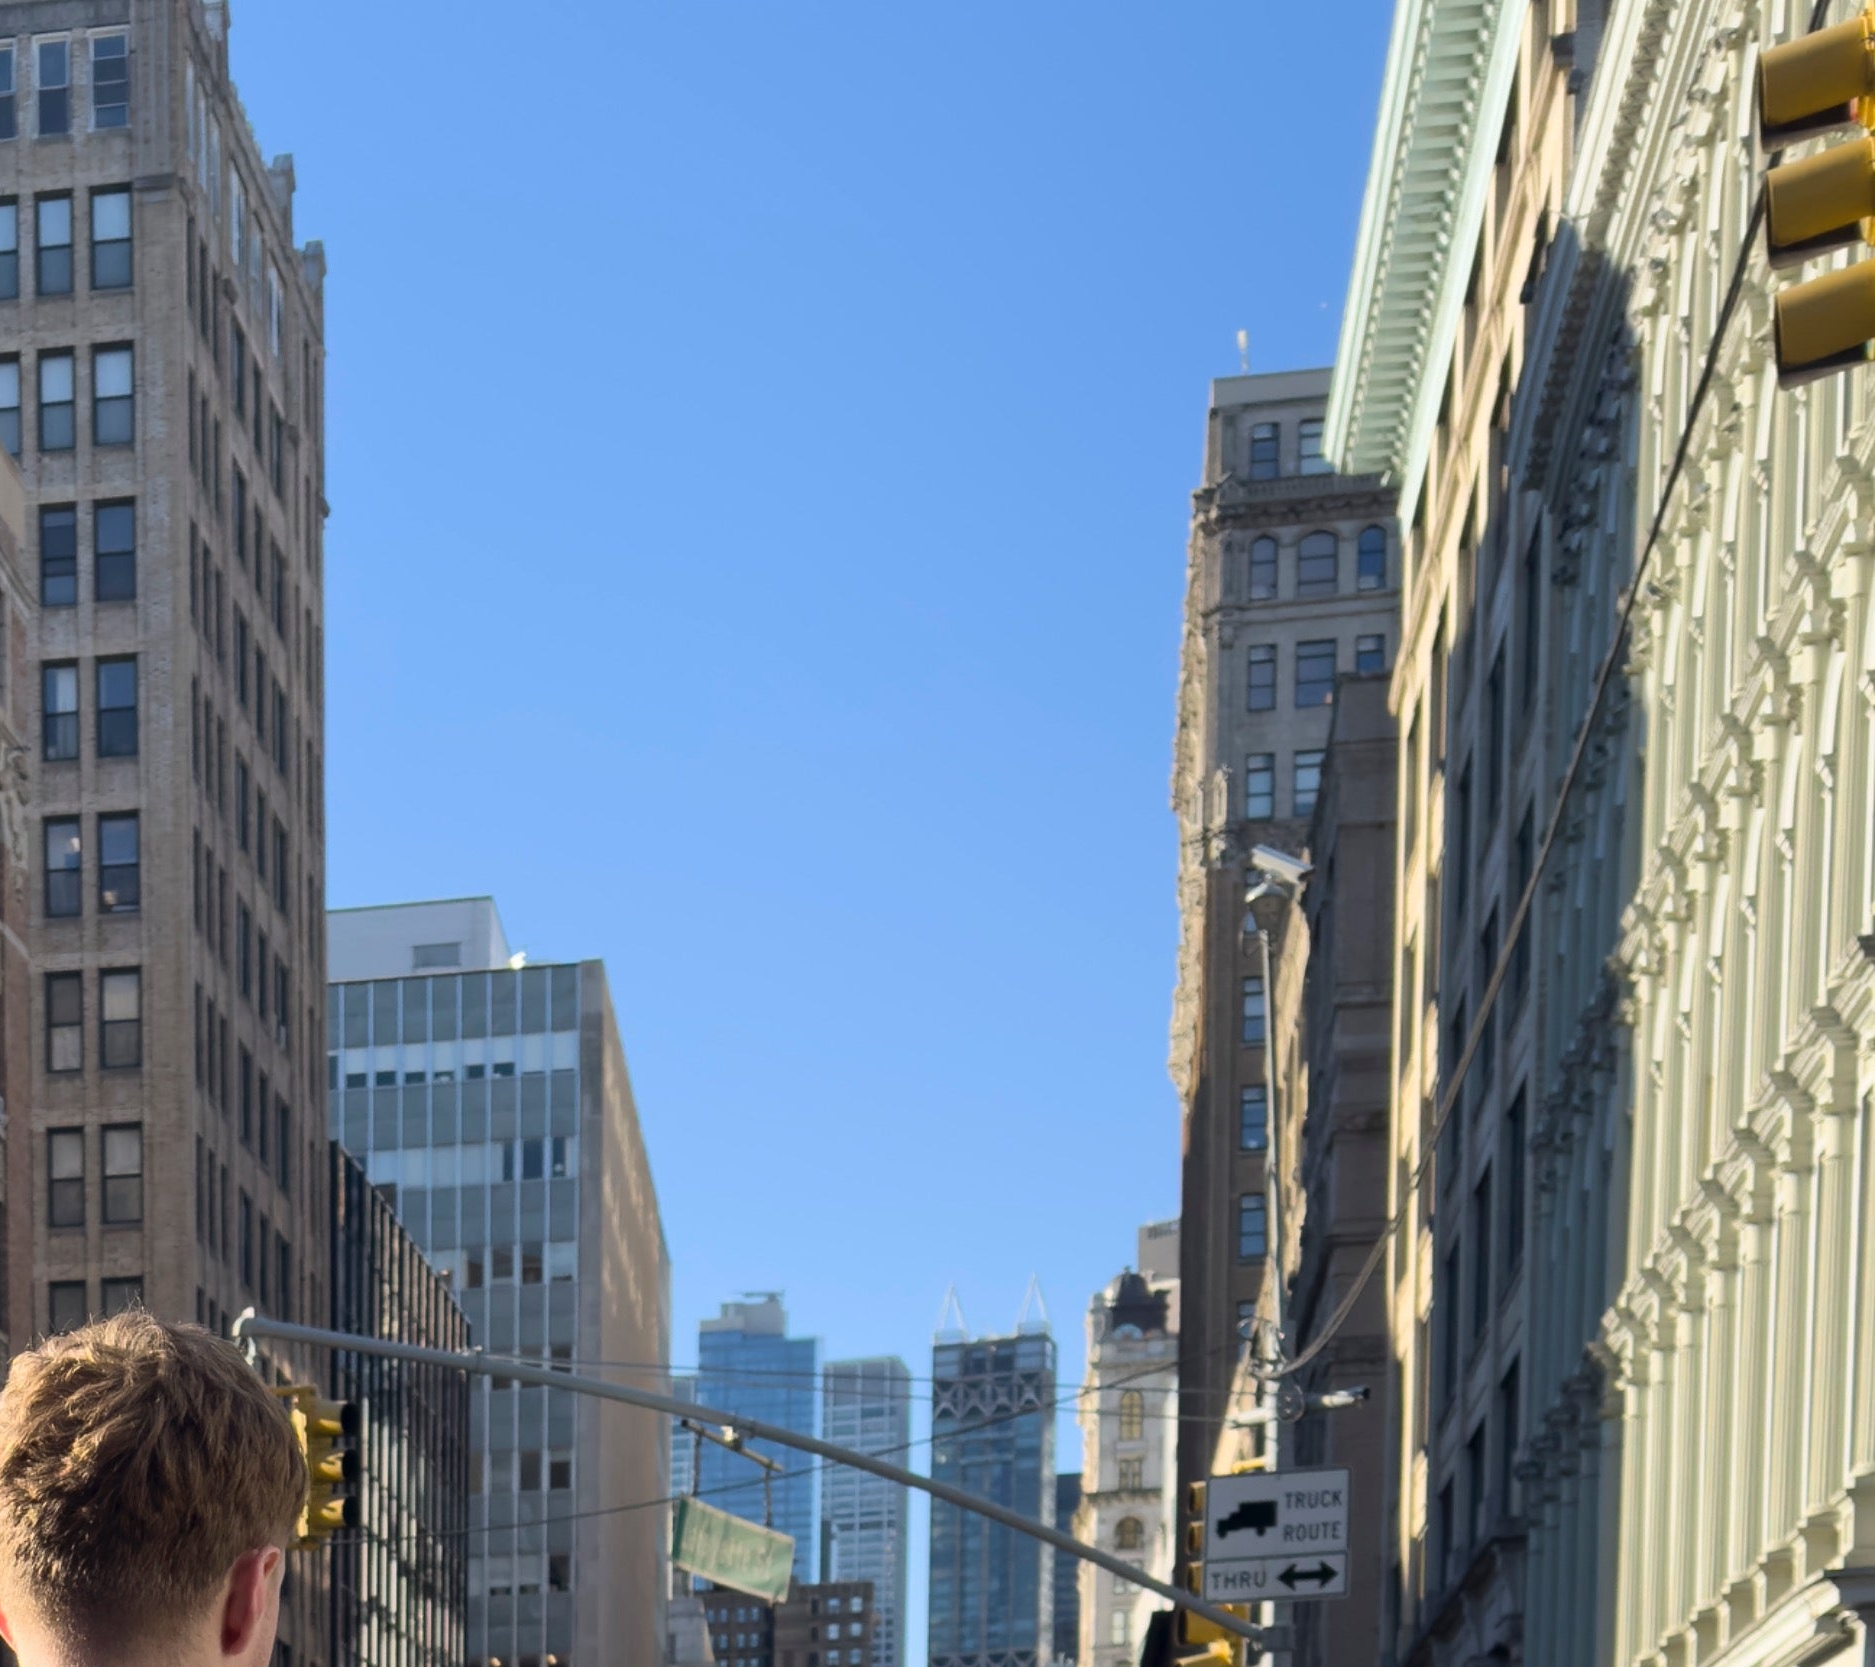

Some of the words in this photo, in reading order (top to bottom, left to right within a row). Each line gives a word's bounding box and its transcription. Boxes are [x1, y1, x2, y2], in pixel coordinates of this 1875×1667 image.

[1285, 1490, 1342, 1509] TRUCK
[1284, 1521, 1341, 1542] ROUTE
[1212, 1570, 1267, 1589] THRU
